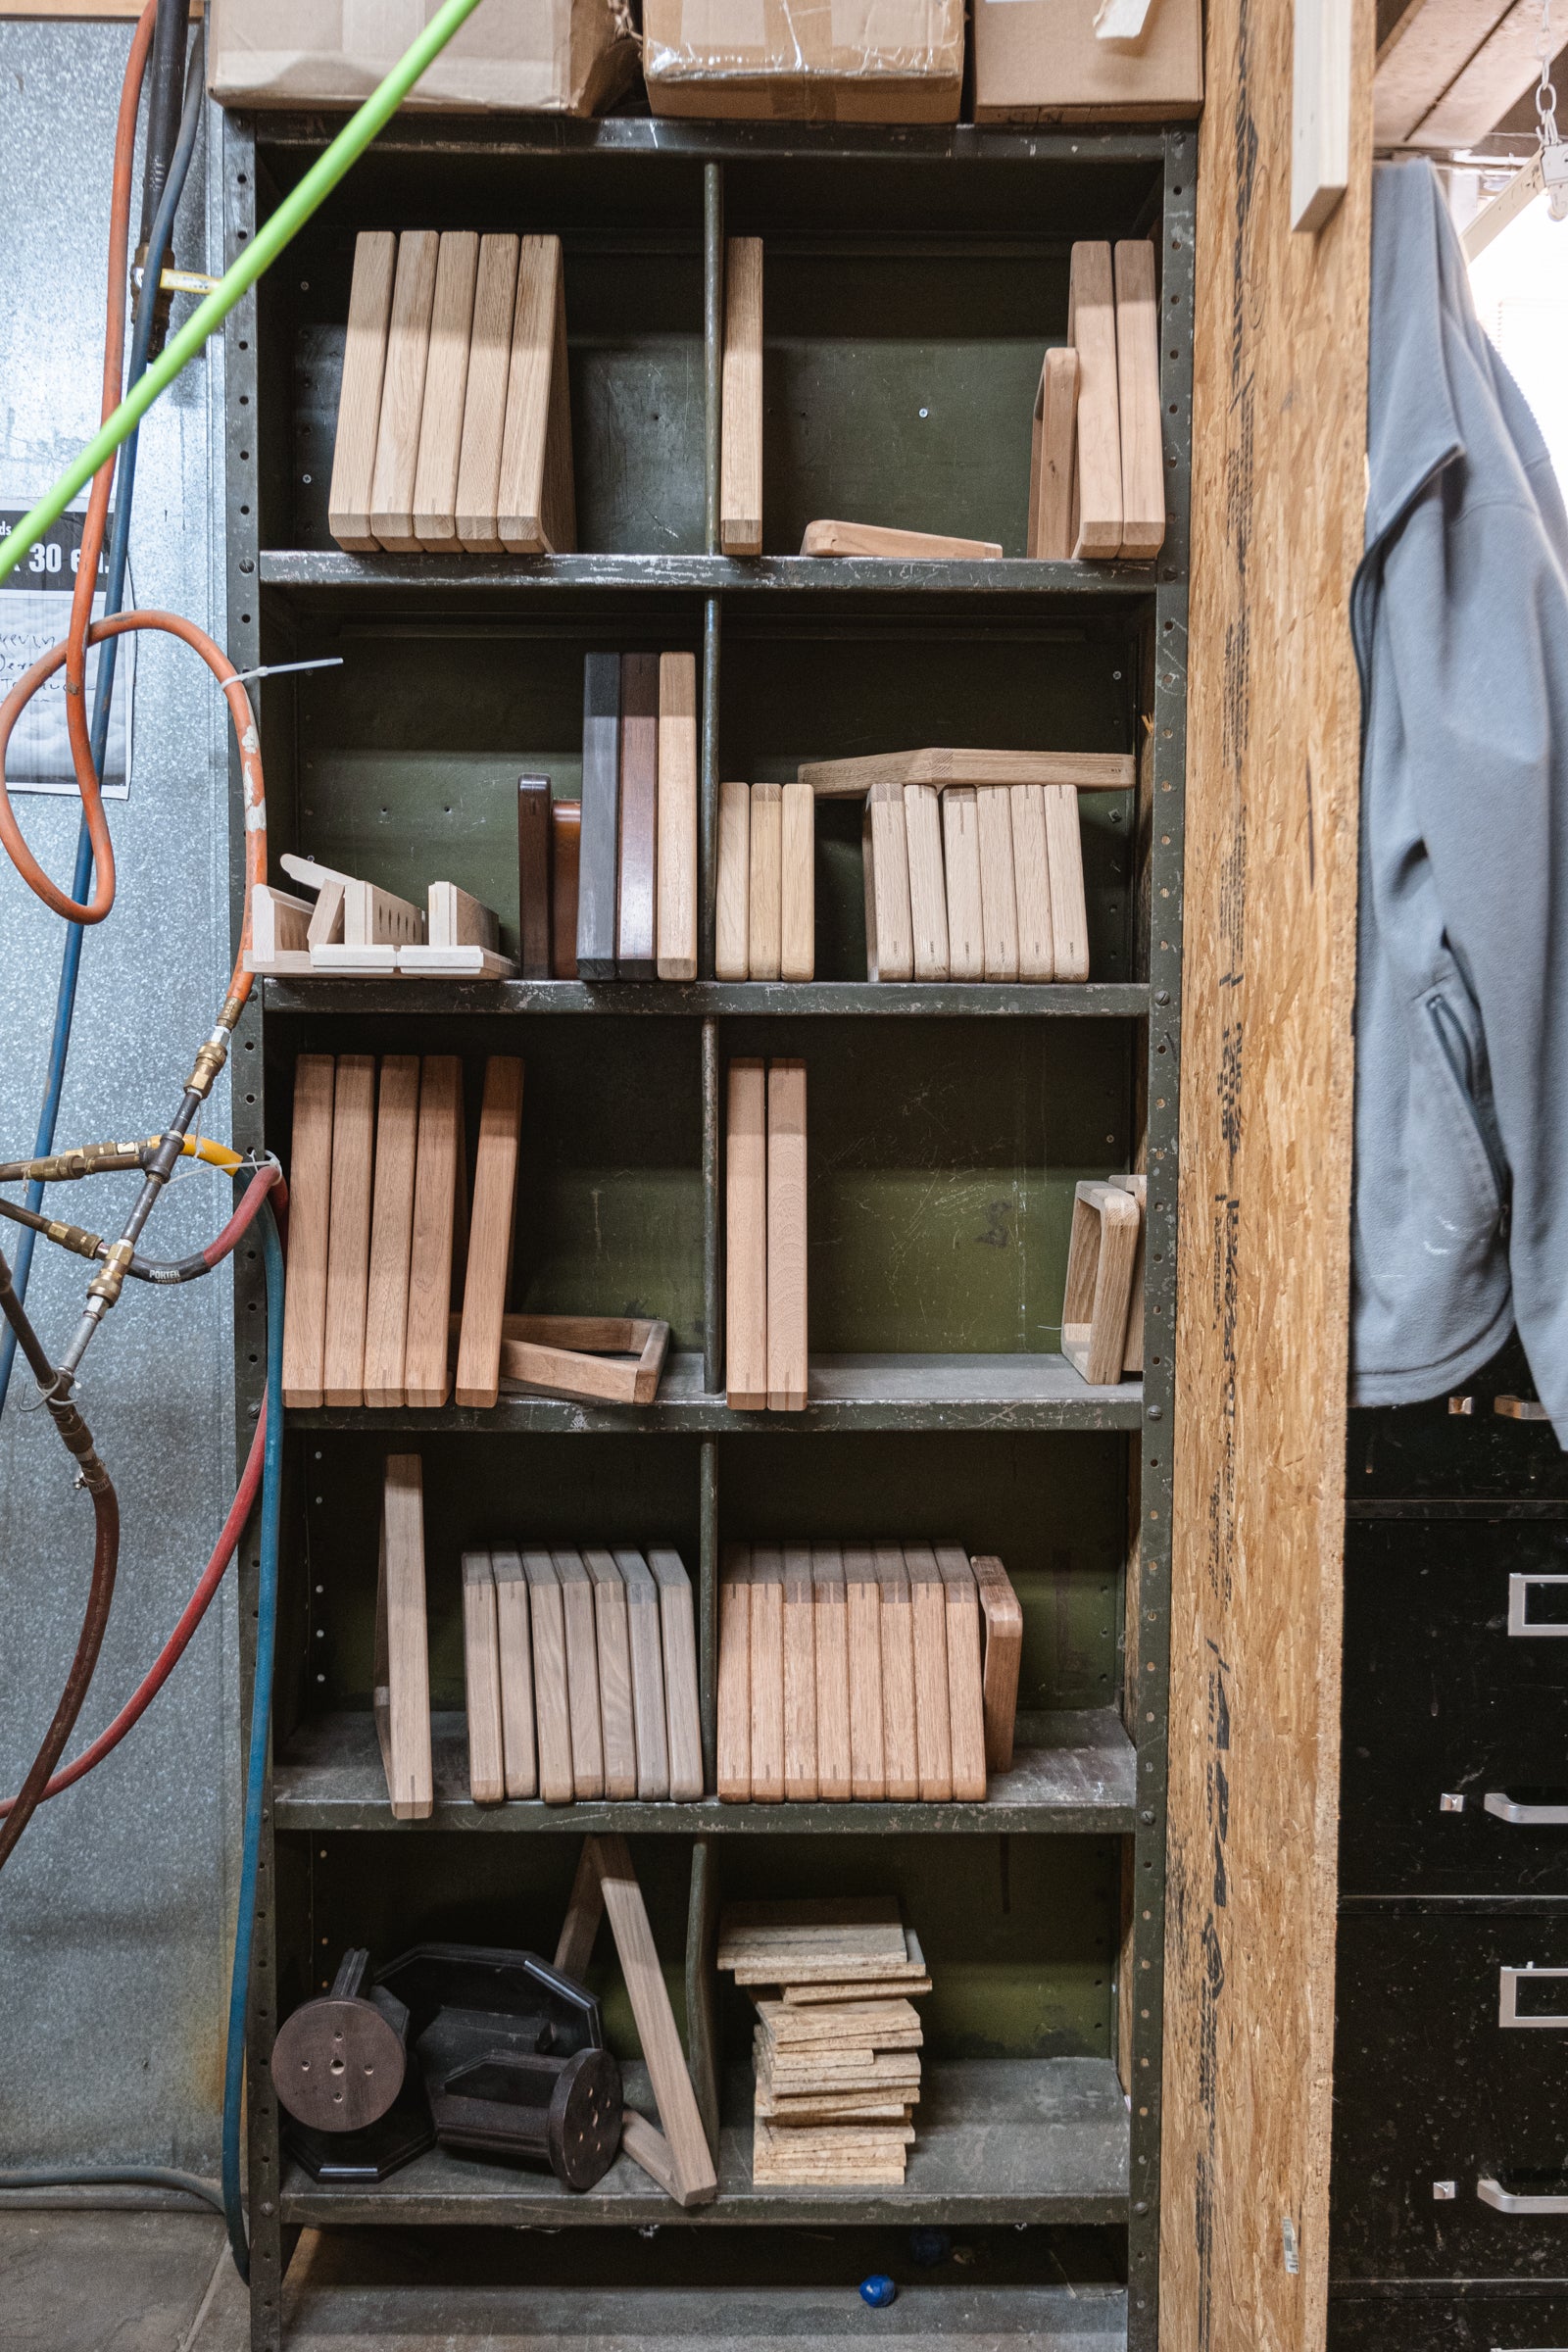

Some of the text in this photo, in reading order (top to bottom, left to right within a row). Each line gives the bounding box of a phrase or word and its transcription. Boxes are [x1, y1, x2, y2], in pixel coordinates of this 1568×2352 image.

[29, 543, 62, 573] 30
[149, 1269, 180, 1280] PORTER
[1213, 1668, 1230, 1908] APA
